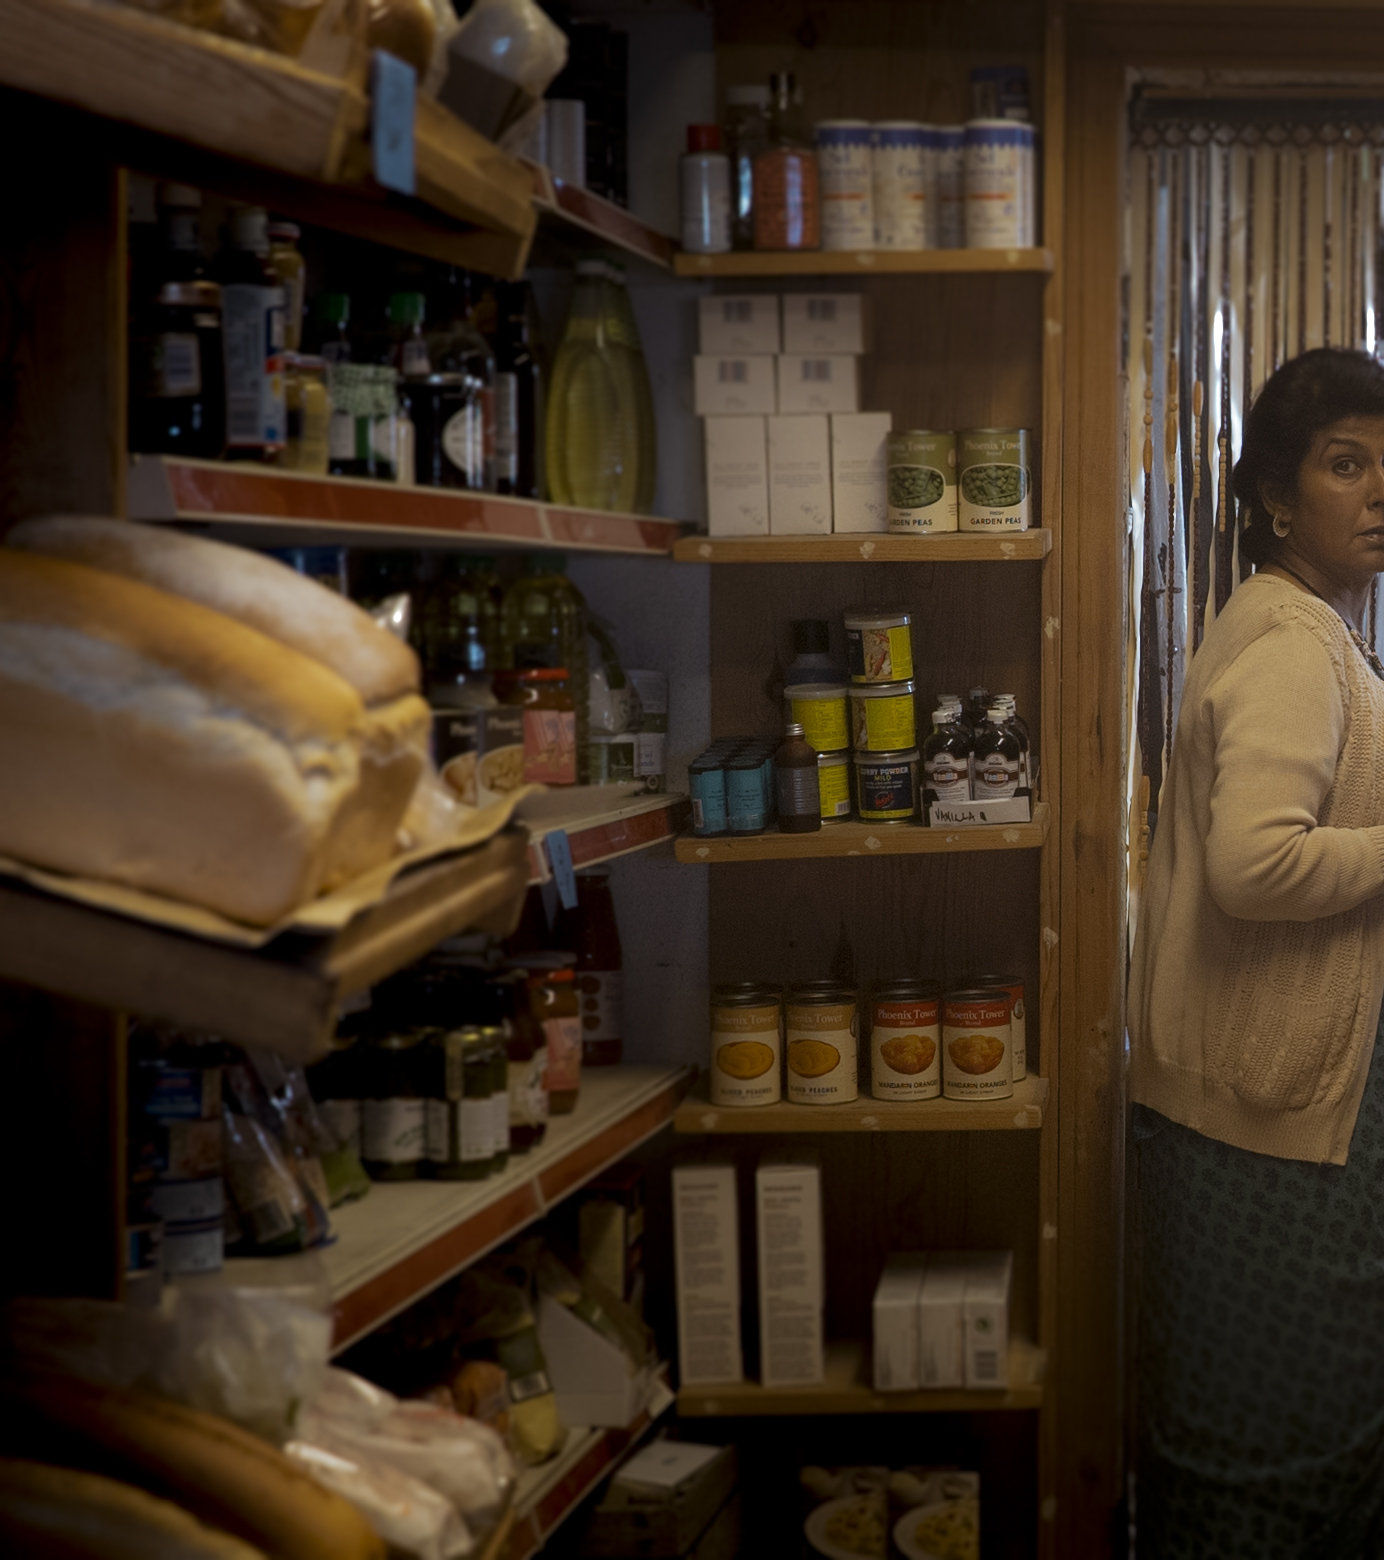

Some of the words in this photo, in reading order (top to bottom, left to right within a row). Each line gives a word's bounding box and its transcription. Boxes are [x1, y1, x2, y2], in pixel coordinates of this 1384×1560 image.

[913, 518, 933, 527] PEAS
[970, 518, 1003, 526] GARDEN
[1005, 517, 1022, 525] PEAS
[815, 1012, 843, 1023] Tower
[877, 1008, 911, 1020] Phoenix
[913, 1008, 937, 1020] Tower
[946, 1008, 977, 1020] Phoenix
[980, 1009, 1005, 1020] Tower
[878, 1081, 912, 1090] MANDARIN
[979, 1080, 1008, 1089] ORANGES
[808, 1086, 838, 1094] PEACHES
